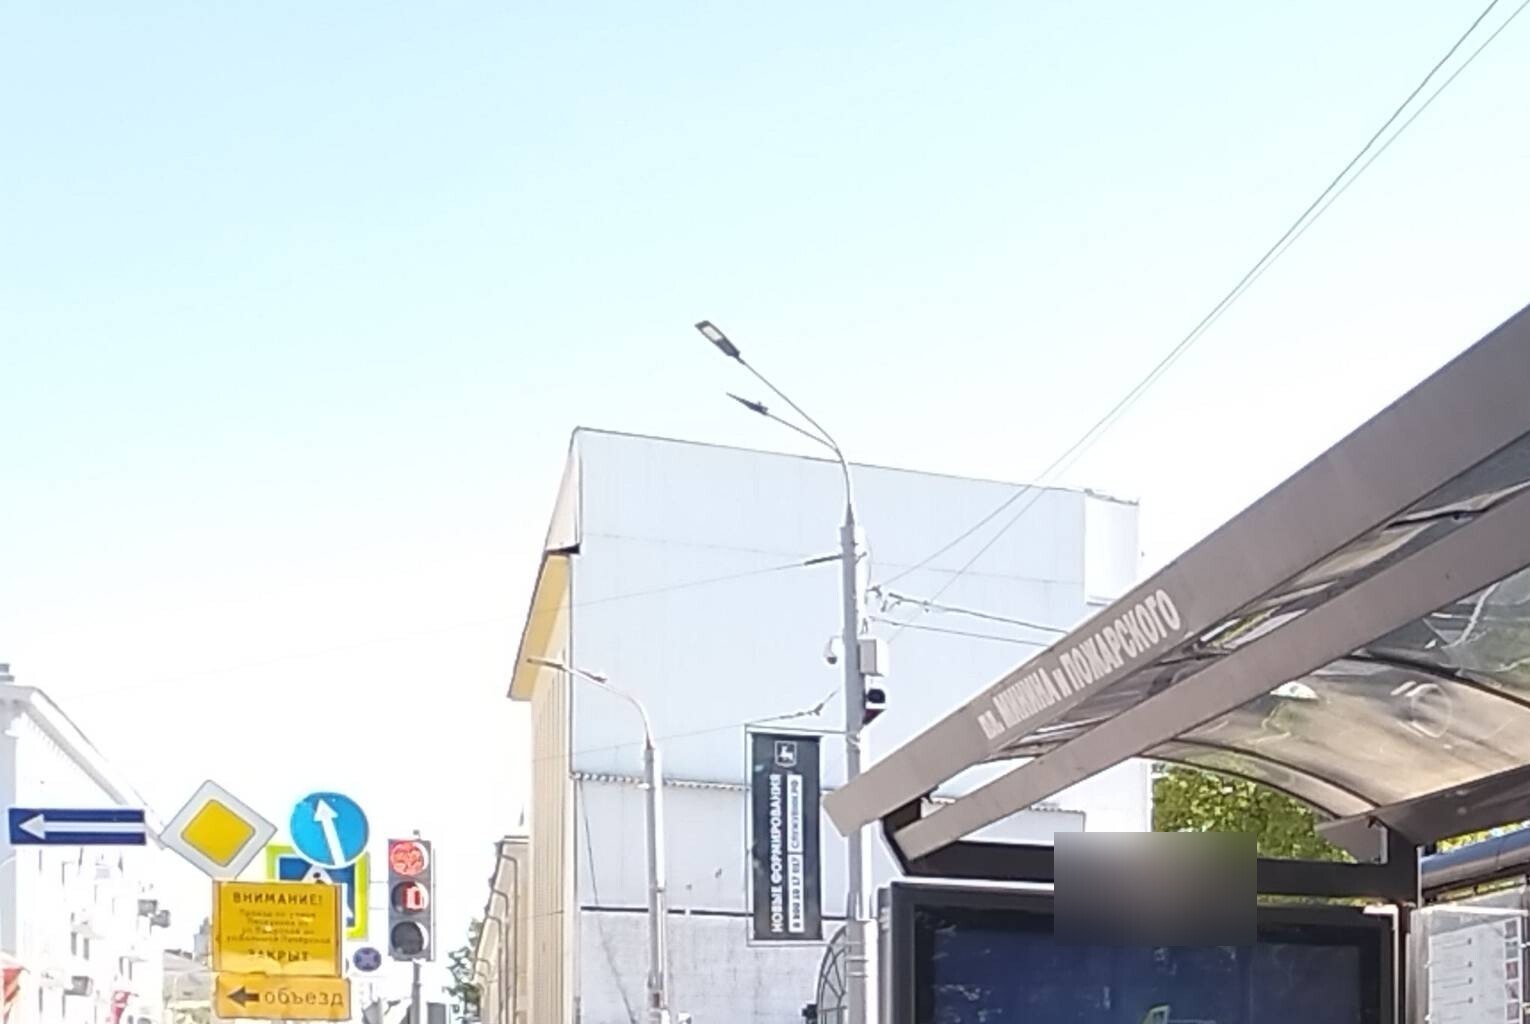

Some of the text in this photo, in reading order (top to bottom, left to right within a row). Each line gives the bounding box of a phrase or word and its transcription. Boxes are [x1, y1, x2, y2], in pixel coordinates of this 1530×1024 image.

[992, 668, 1062, 729] МИНИНА
[1059, 589, 1181, 691] ПОЖАРСКОГО
[769, 774, 783, 933] НОВЫЕ ФОРМИРОВАНИЯ
[233, 892, 322, 906] ВНИМАНИЕ!
[264, 987, 344, 1007] объезд
